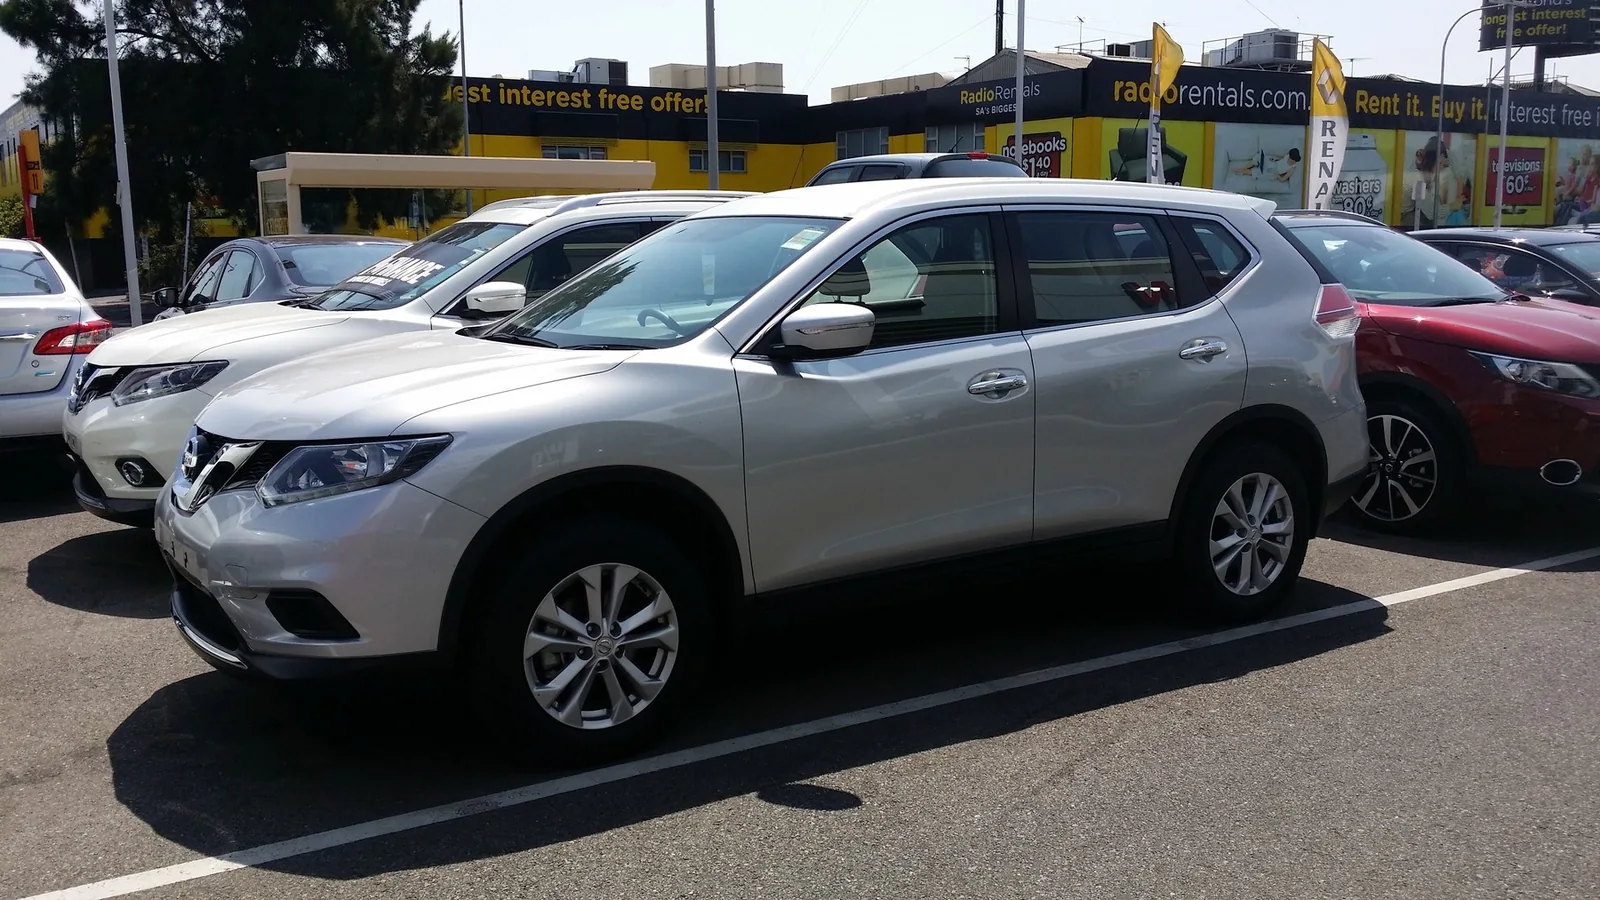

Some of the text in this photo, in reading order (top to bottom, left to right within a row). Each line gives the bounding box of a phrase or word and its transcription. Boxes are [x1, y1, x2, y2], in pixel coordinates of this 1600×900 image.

[1483, 8, 1586, 25] longst interest
[1496, 24, 1567, 38] fre offer!
[499, 83, 591, 109] interest
[598, 88, 643, 111] free
[650, 92, 709, 113] offer!
[960, 81, 1040, 104] RadioRenals
[1114, 77, 1311, 112] radorentals.com.
[975, 106, 990, 115] SA's
[1355, 90, 1400, 115] Rent
[1406, 92, 1424, 117] it.
[1431, 95, 1465, 124] Buy
[1471, 97, 1487, 120] it.
[1494, 100, 1556, 124] Iterest
[1562, 104, 1591, 126] free
[1003, 137, 1067, 158] noebooks
[1492, 159, 1541, 173] tevisions
